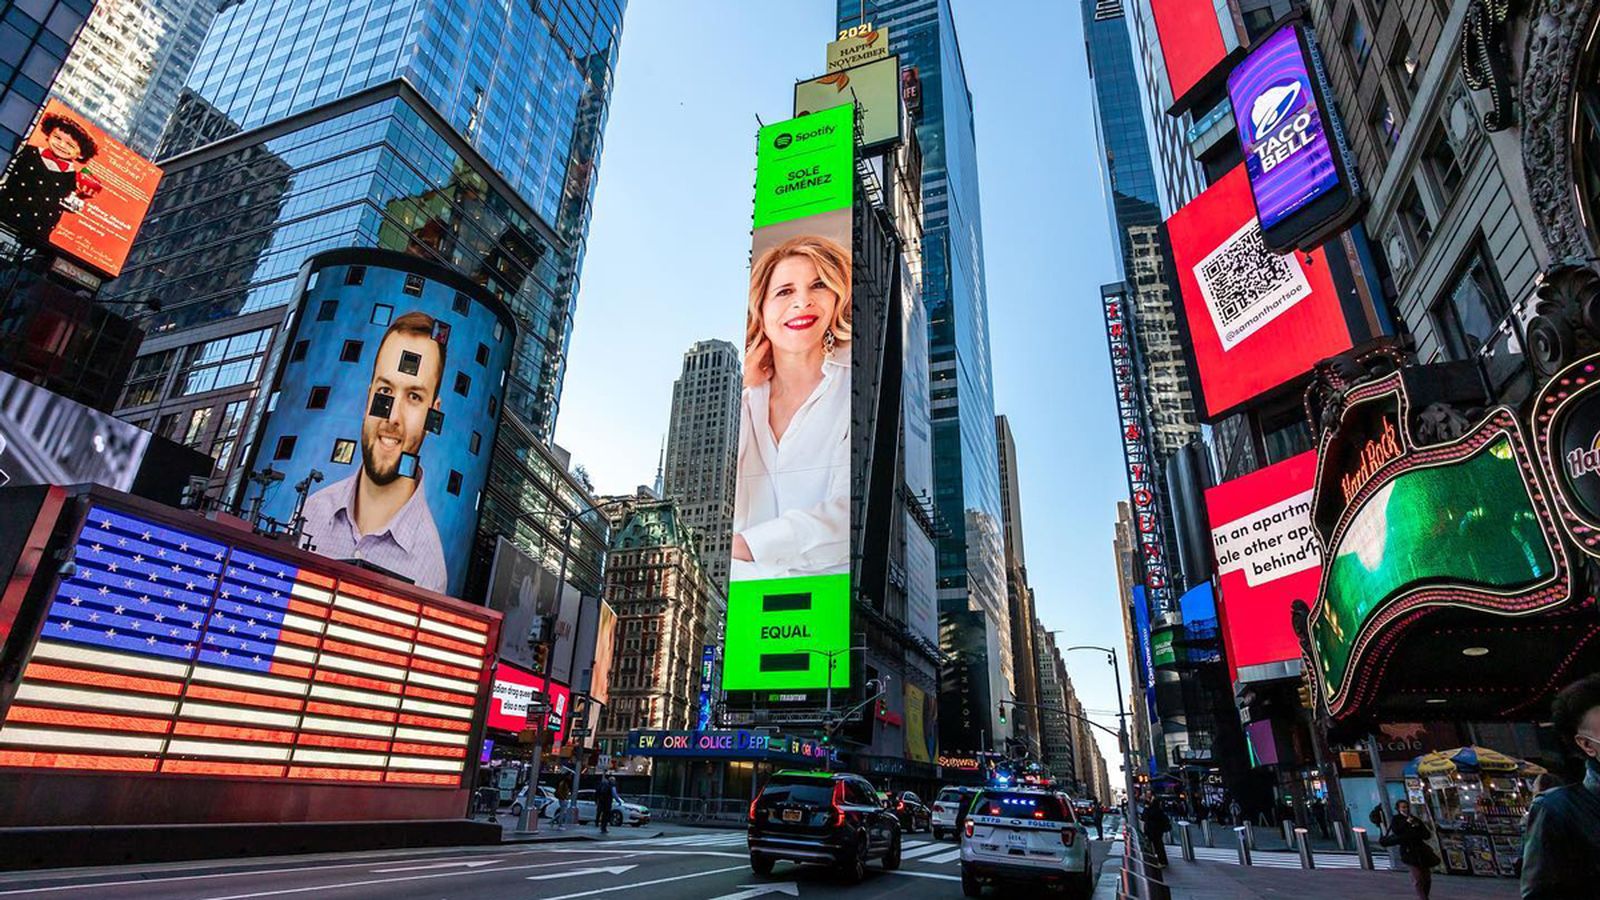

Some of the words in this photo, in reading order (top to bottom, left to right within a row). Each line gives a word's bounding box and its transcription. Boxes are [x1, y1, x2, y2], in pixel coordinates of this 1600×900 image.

[839, 23, 872, 40] 2021
[829, 47, 886, 69] NOVEMBER
[796, 126, 836, 142] Spotify
[1254, 112, 1311, 156] TACO
[1261, 130, 1317, 174] BELL
[787, 165, 820, 181] SOLE
[1566, 447, 1600, 477] Ha
[1130, 463, 1165, 588] YOUNG
[1214, 533, 1228, 546] in
[1231, 526, 1249, 539] an
[1252, 501, 1310, 531] apartm
[1220, 550, 1240, 565] ole
[1244, 534, 1283, 556] other
[1252, 545, 1307, 576] behind
[761, 625, 811, 639] EQUAL
[981, 816, 1001, 824] NYPD
[1028, 820, 1056, 828] POLICE
